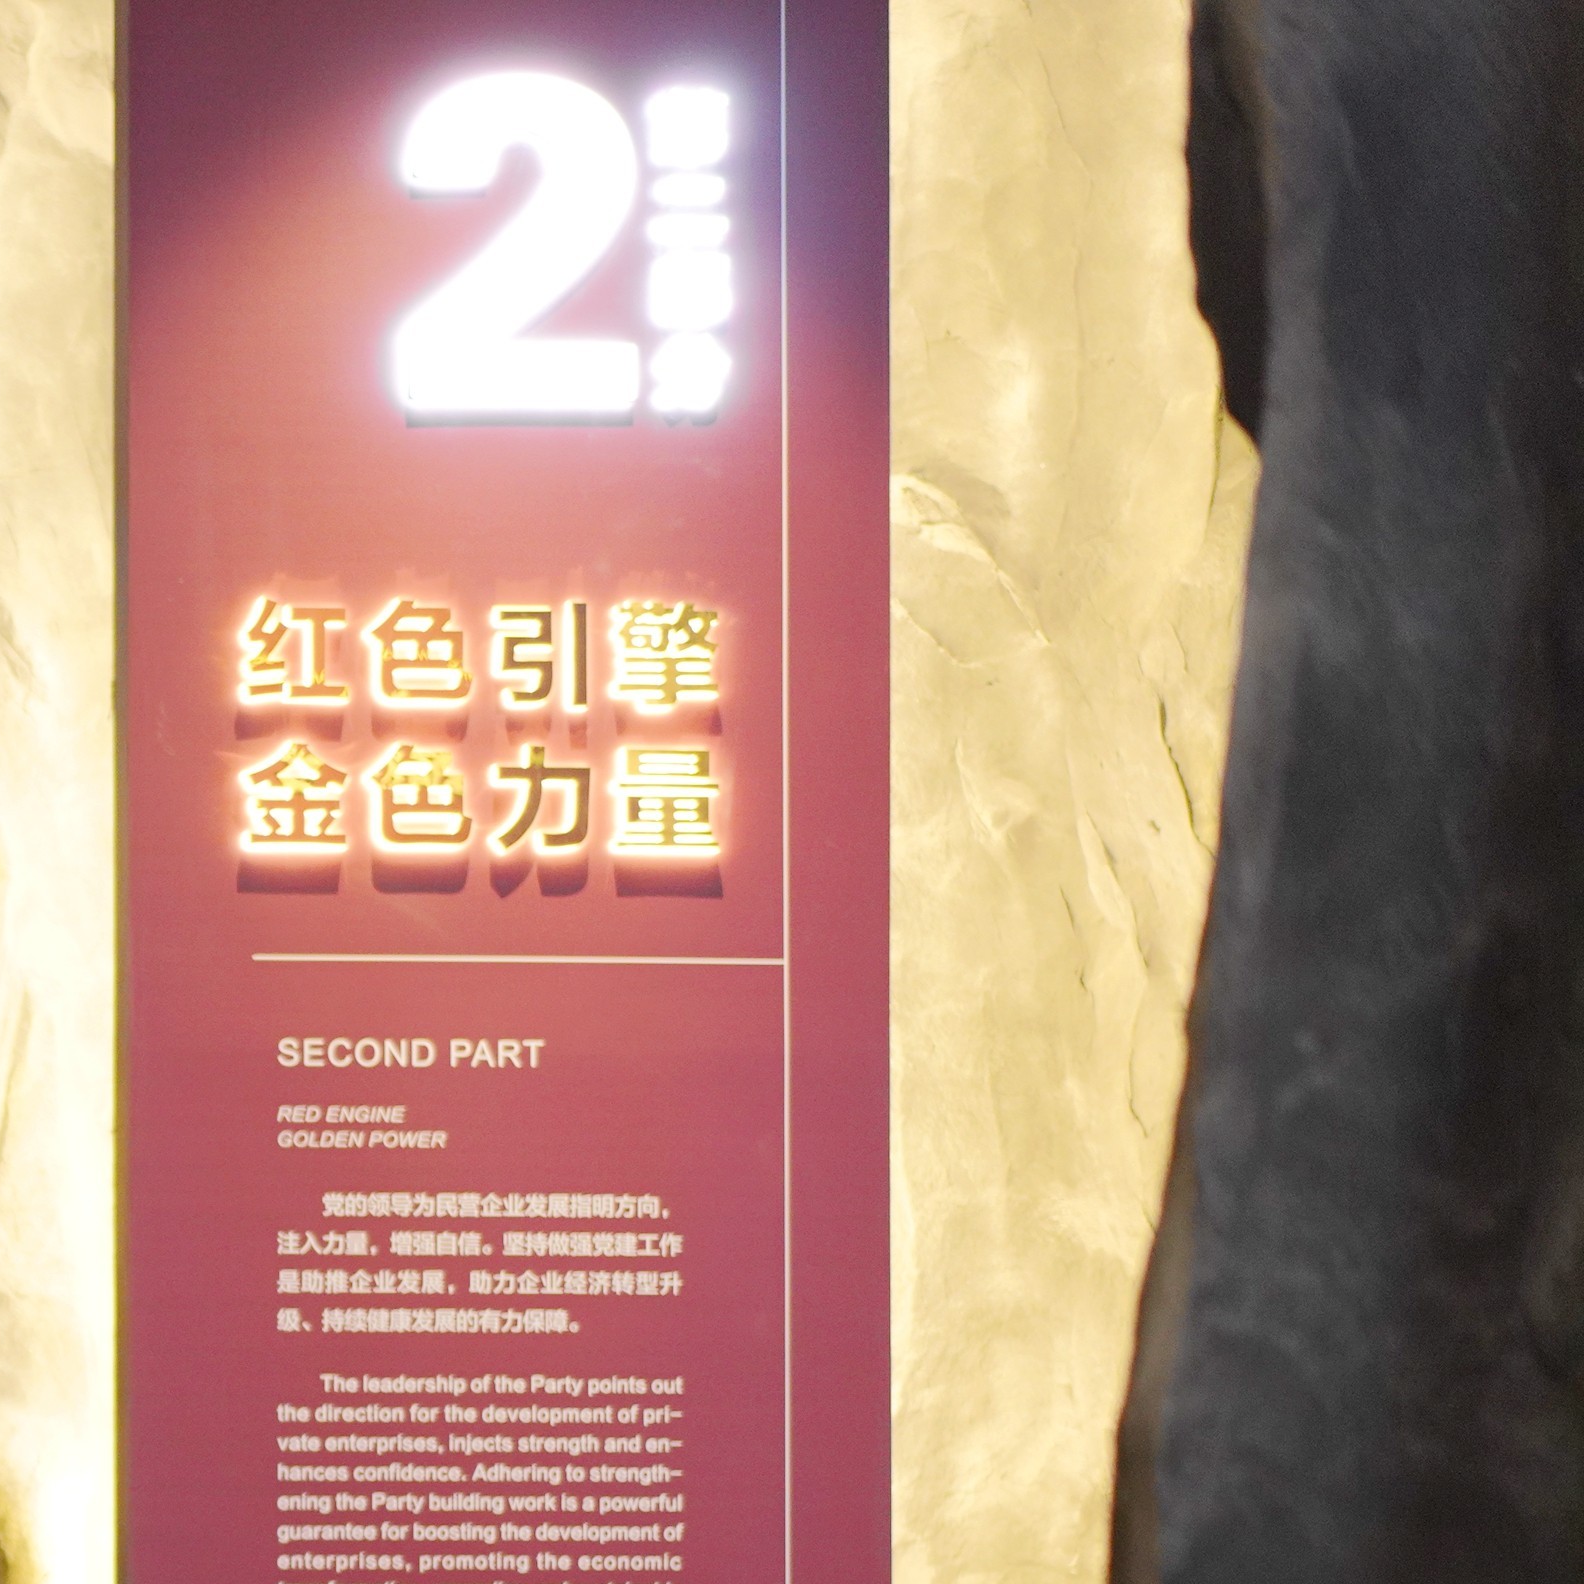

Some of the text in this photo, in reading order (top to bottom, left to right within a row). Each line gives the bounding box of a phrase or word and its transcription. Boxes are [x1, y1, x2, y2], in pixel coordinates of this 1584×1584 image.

[399, 70, 639, 412] 2
[238, 596, 720, 715] 红色引擎
[239, 742, 721, 857] 金色力量
[276, 1036, 546, 1069] SECOND PART
[276, 1104, 407, 1124] RED ENGINE
[276, 1129, 448, 1149] GOLDEN POWER
[319, 1373, 684, 1398] The leadership of the Party points out
[276, 1402, 683, 1427] the direction for the development of pri-
[276, 1433, 683, 1457] vate enterprises, injects strength and en-
[277, 1462, 683, 1487] hances confidence. Adhering to strength-
[276, 1491, 684, 1516] ening the Party building work is a powerful
[276, 1521, 685, 1545] guarantee for boosting the development of
[276, 1551, 682, 1574] enterprises, promoting the economic
